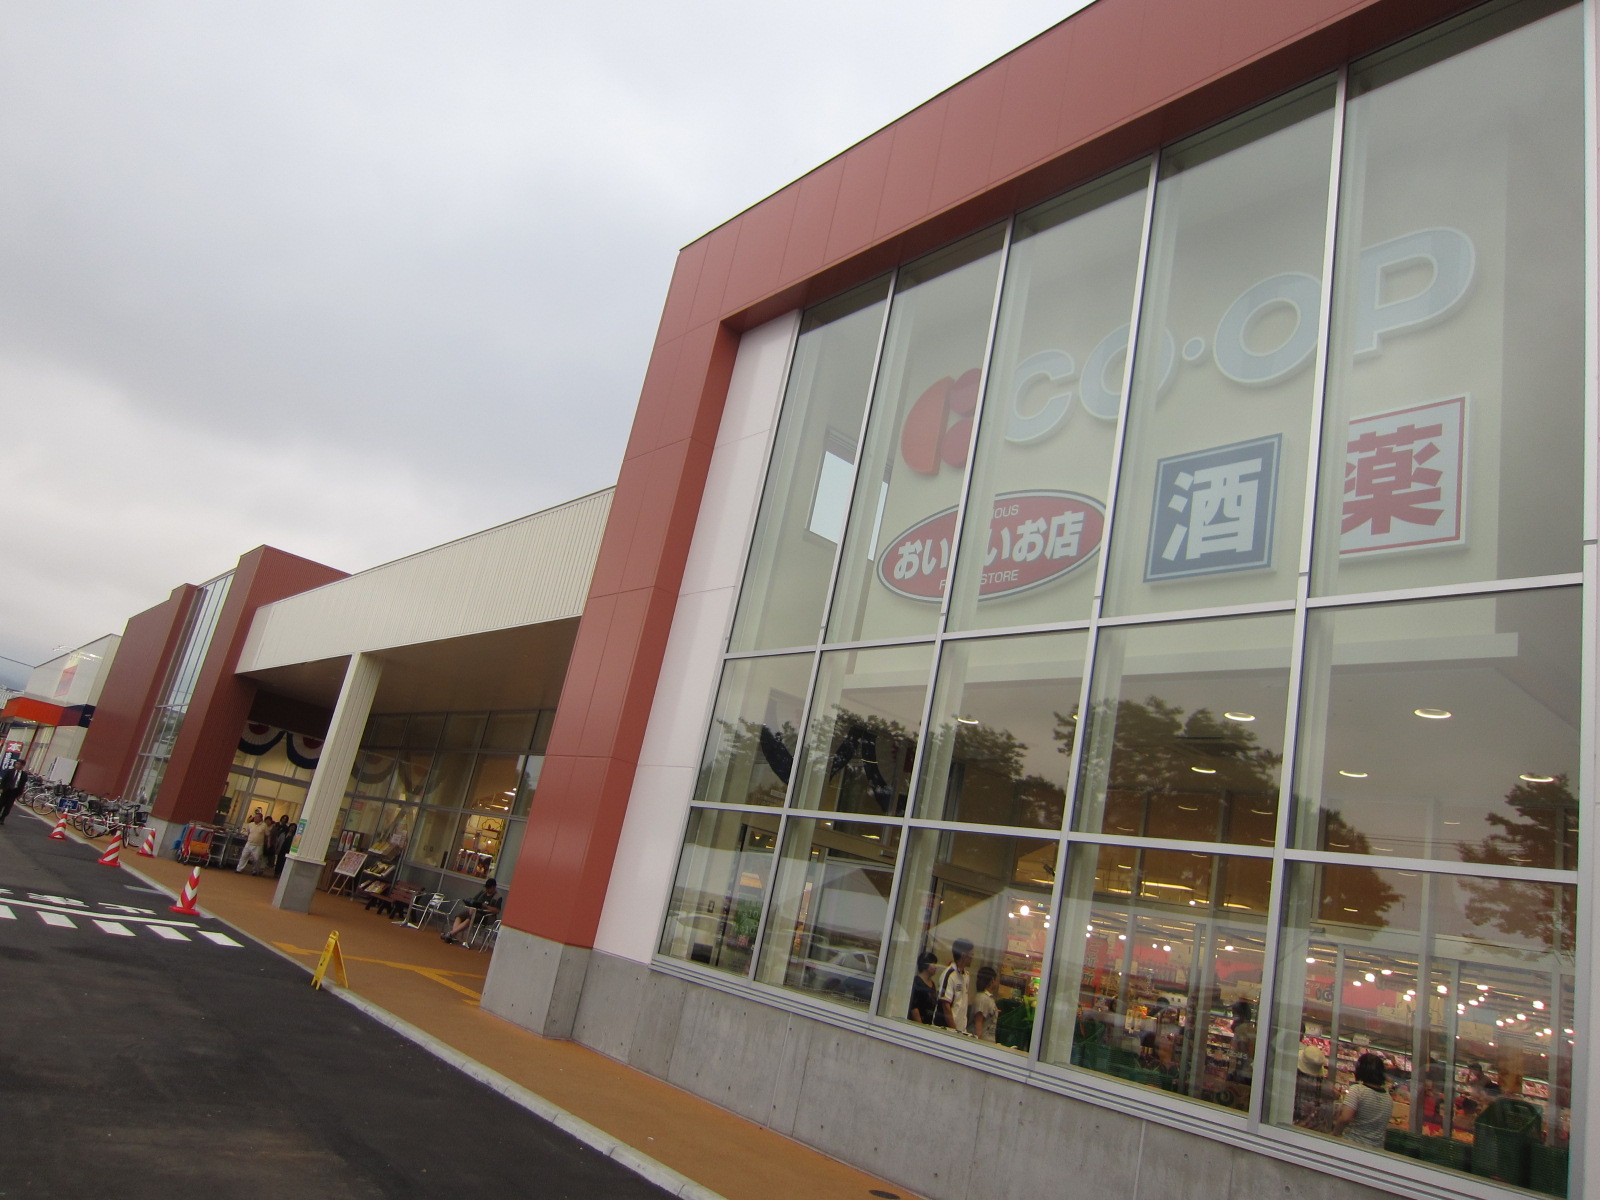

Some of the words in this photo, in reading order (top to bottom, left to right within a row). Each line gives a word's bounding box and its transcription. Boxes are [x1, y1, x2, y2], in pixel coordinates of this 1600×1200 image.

[1161, 457, 1263, 561] 酒
[1340, 423, 1445, 536] 薬
[893, 510, 1085, 580] おいいお店
